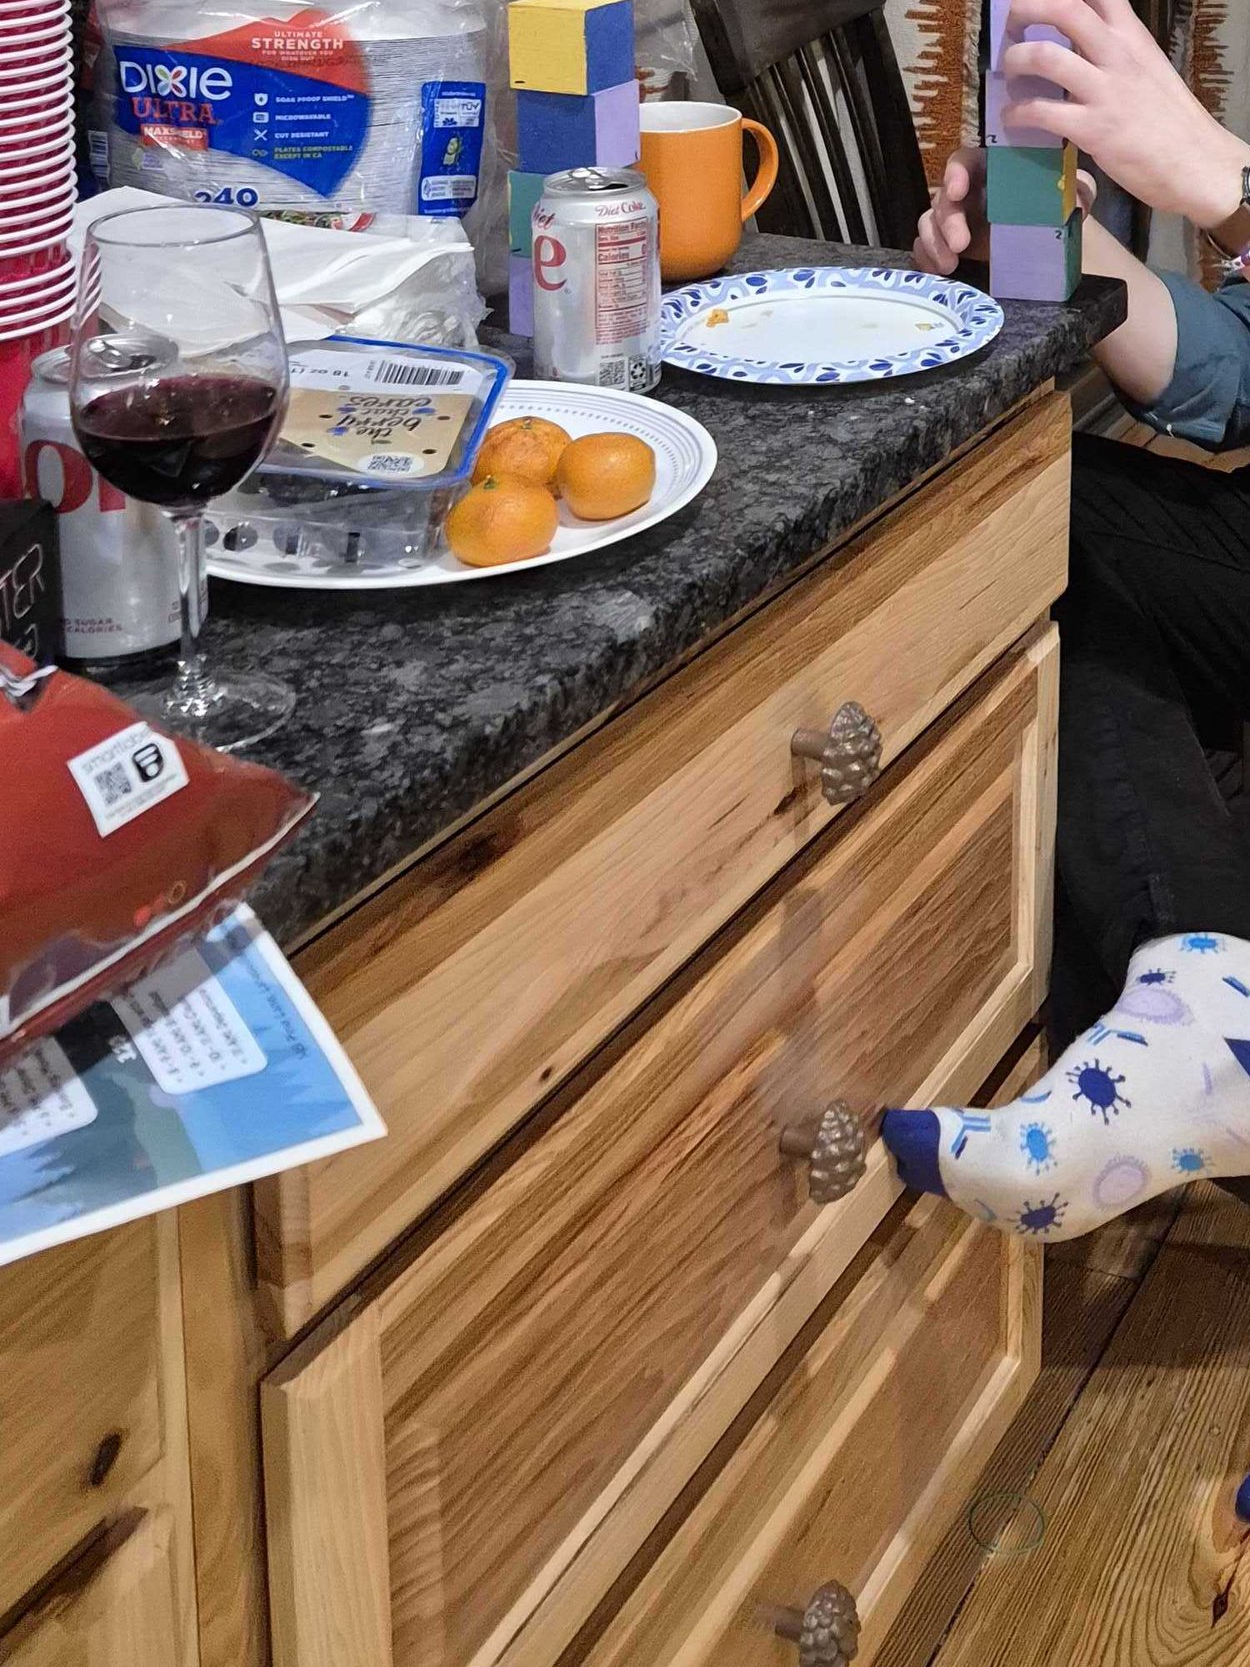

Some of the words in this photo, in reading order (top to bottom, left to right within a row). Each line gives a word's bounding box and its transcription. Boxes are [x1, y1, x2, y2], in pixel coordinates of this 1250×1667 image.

[251, 37, 344, 50] STRENGTH
[119, 60, 233, 100] DIXIE
[132, 96, 218, 126] ULTRA
[194, 186, 258, 207] 240
[595, 204, 619, 217] Diet
[620, 201, 647, 214] Coke
[599, 252, 630, 262] Calories
[349, 396, 432, 407] cares
[361, 407, 411, 416] that
[335, 412, 422, 432] berry
[356, 426, 393, 439] the
[75, 617, 112, 625] SUGAR
